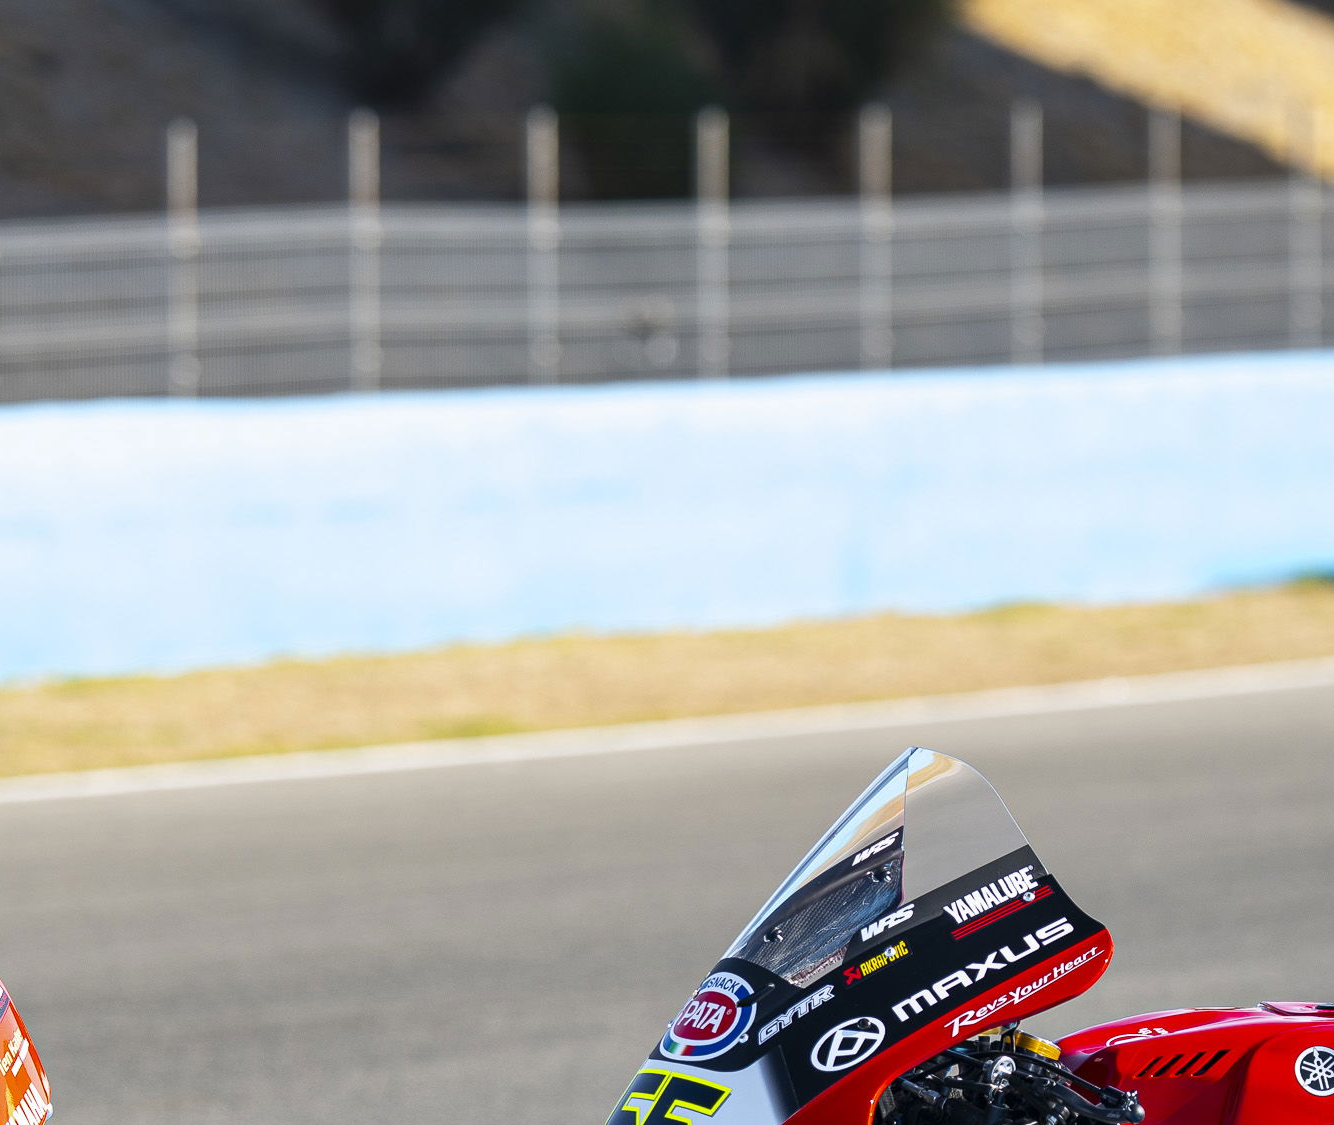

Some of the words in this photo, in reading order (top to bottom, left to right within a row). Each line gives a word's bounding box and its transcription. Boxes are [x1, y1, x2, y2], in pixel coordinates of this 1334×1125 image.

[851, 831, 900, 867] WRS
[943, 865, 1039, 924] YAMALUBE
[860, 903, 915, 942] WRS
[707, 976, 740, 993] SNACK
[891, 917, 1075, 1022] MAXUS
[944, 995, 1008, 1037] Revs
[1009, 972, 1054, 1005] Your
[1052, 946, 1099, 977] Heart
[678, 1000, 721, 1034] PATA
[758, 983, 835, 1045] GYTR
